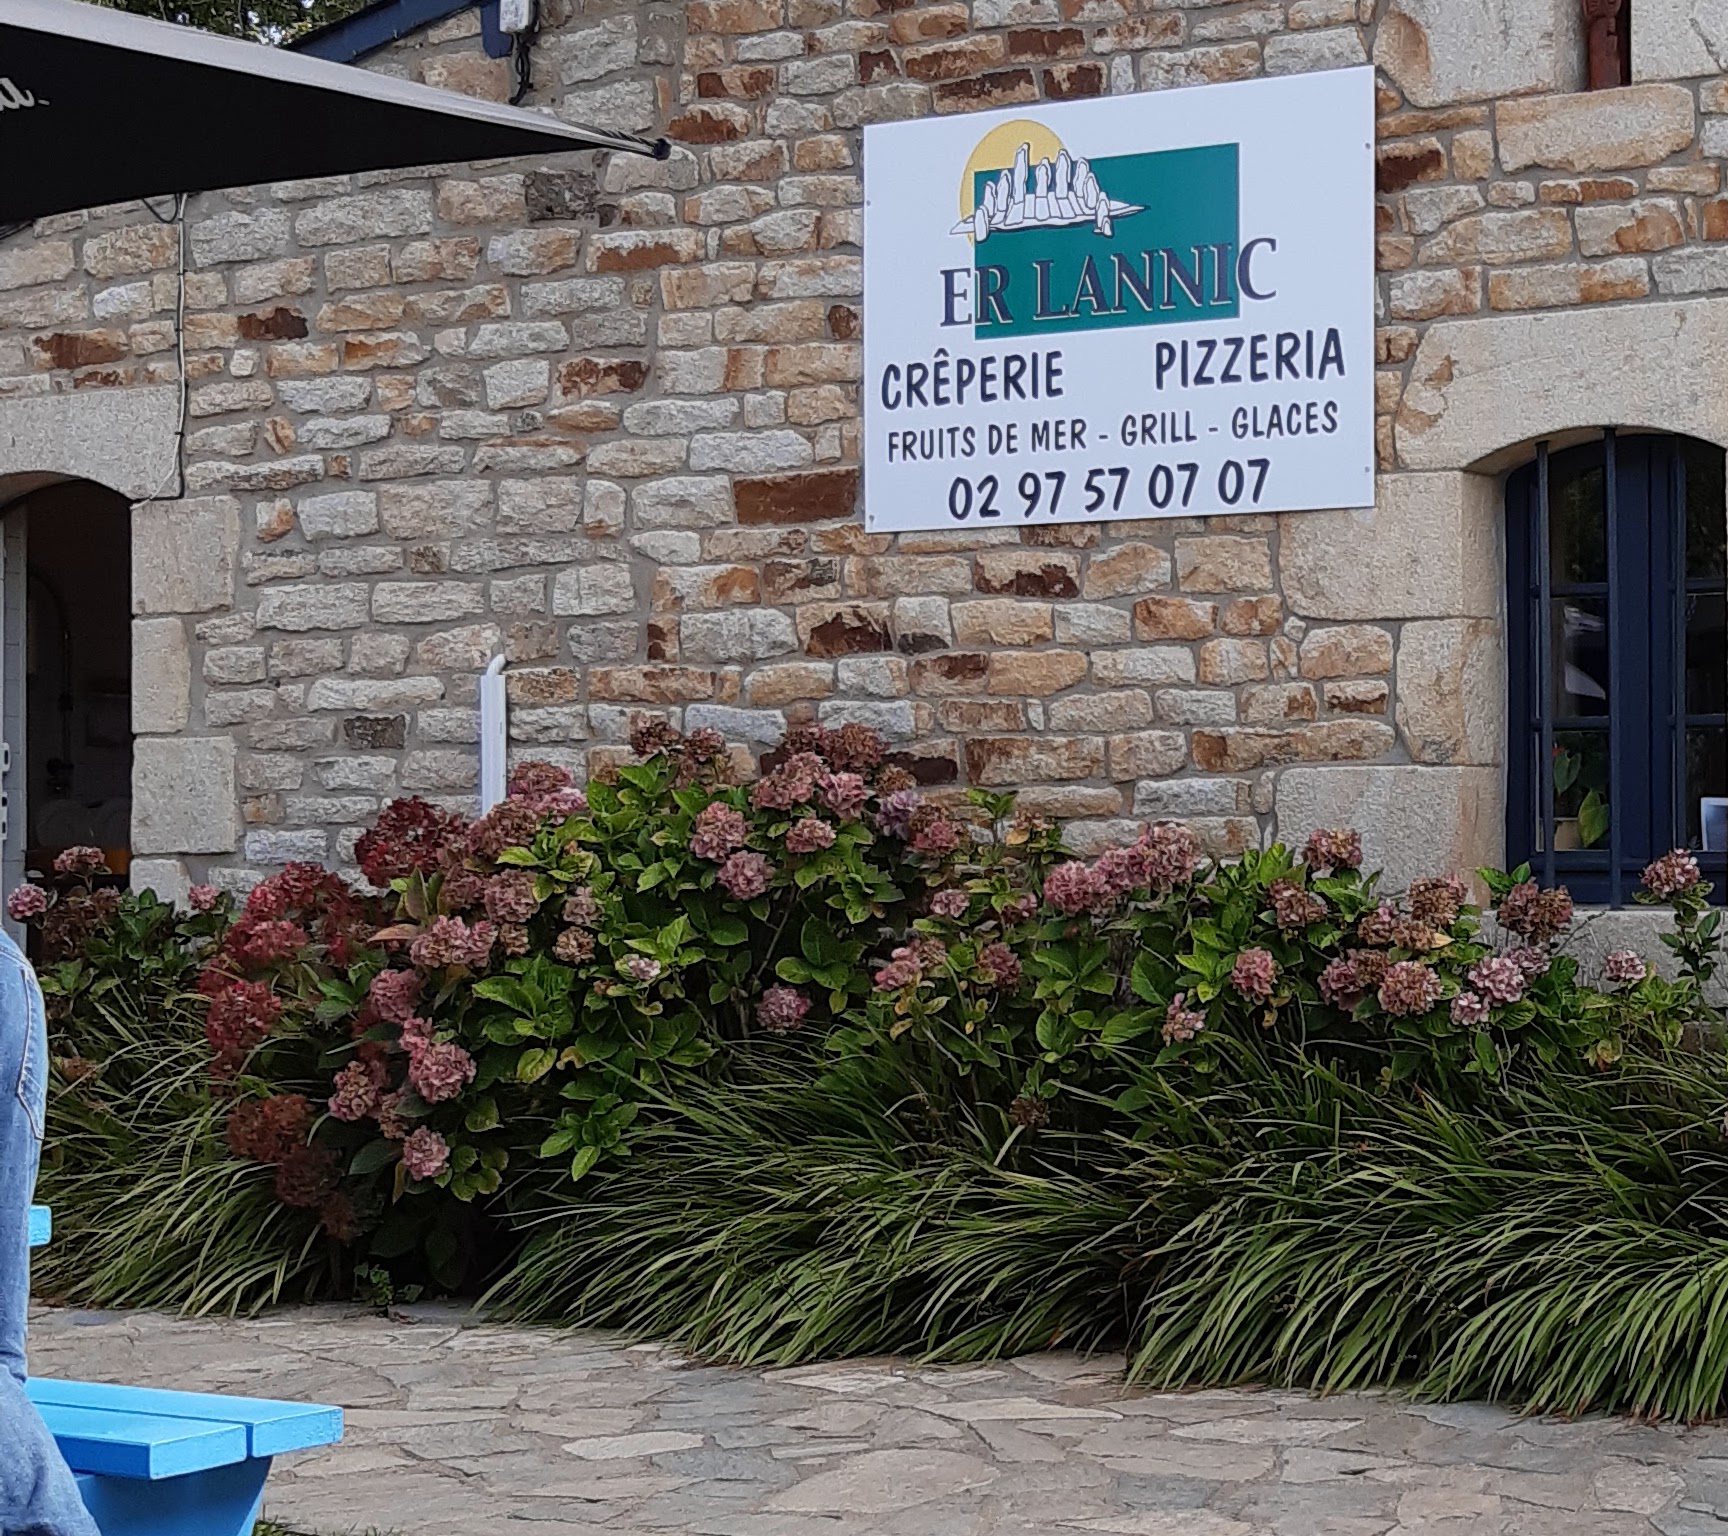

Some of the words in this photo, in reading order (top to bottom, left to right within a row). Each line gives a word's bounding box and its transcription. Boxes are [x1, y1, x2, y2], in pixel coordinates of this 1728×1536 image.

[940, 264, 1014, 327] ER
[1032, 237, 1278, 321] LANNIC
[881, 347, 1064, 411] CRÊPERIE
[1155, 327, 1346, 391] PIZZERIA
[887, 424, 976, 464] FRUITS
[988, 421, 1019, 457] DE
[1031, 418, 1088, 453] MER
[1120, 410, 1199, 448] GRILL
[1231, 400, 1339, 440] GLACES
[948, 474, 1002, 521] 02
[1017, 469, 1068, 519] 97
[1084, 466, 1131, 515] 57
[1148, 461, 1201, 510] 07
[1217, 456, 1272, 507] 07
